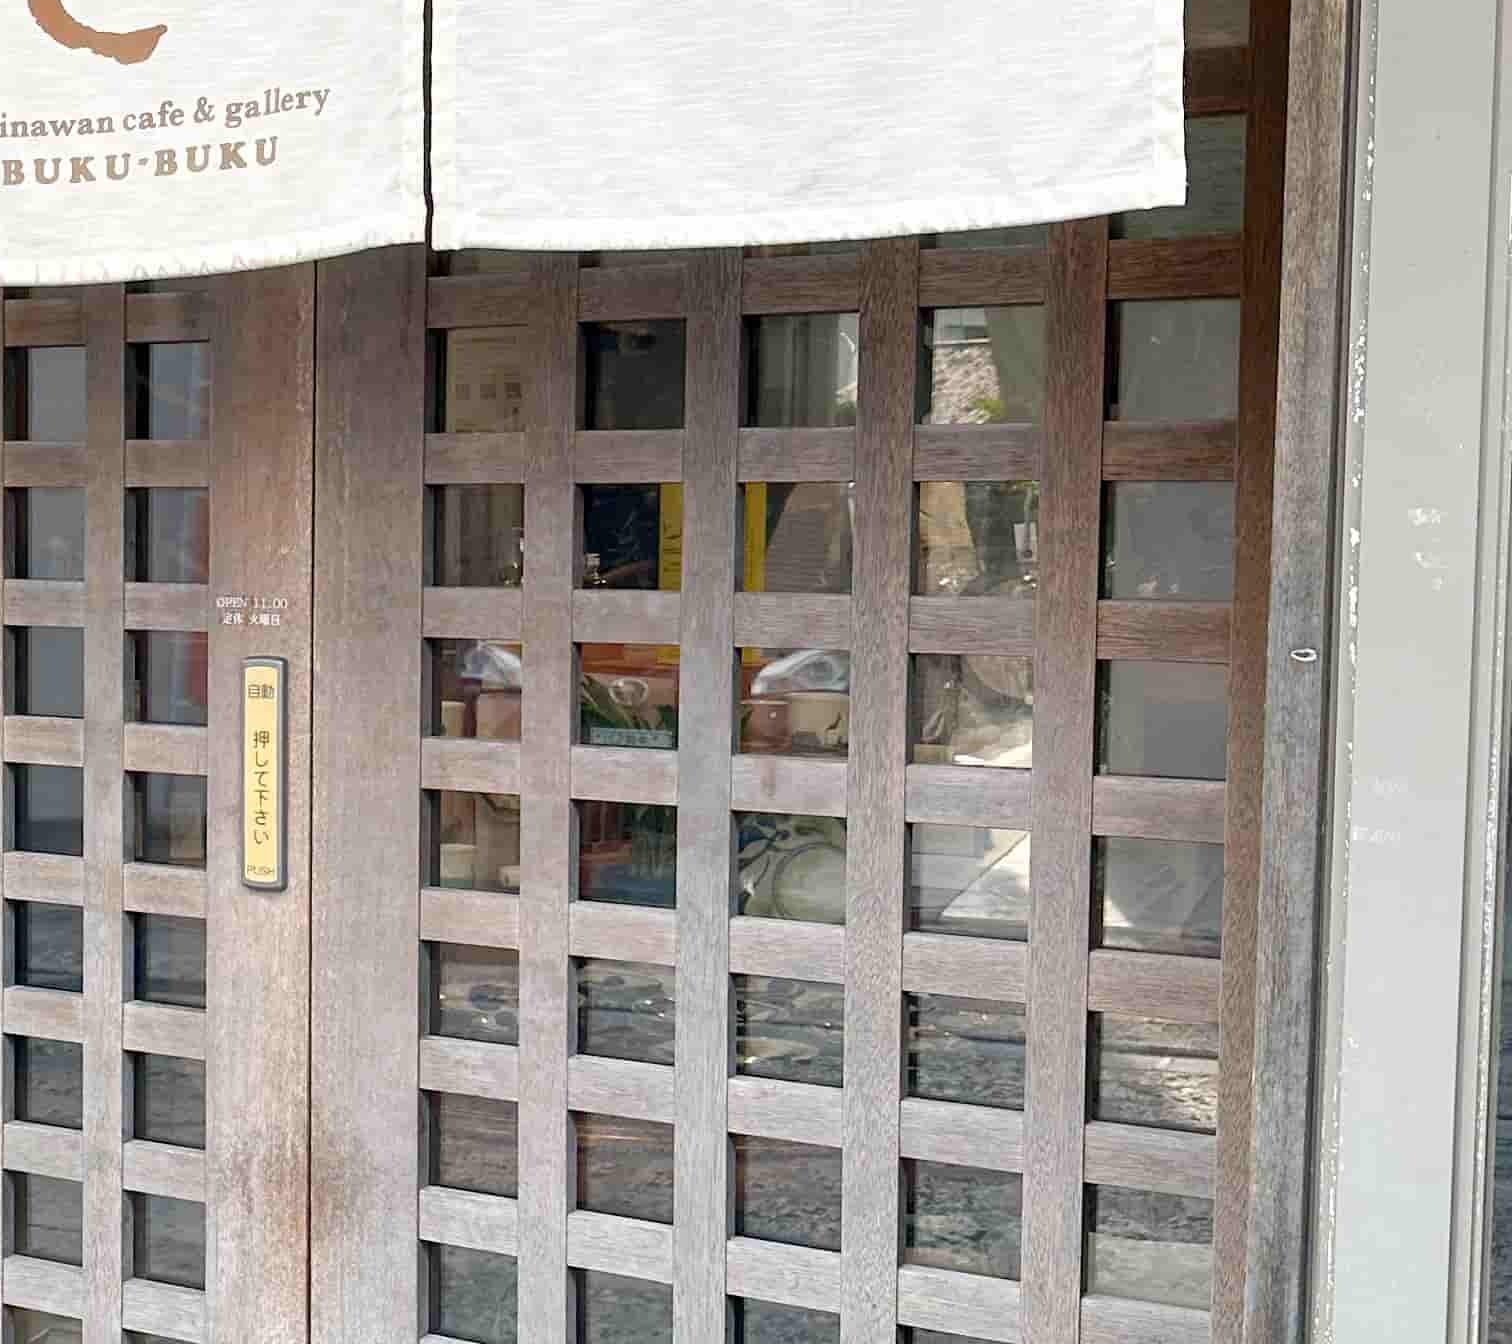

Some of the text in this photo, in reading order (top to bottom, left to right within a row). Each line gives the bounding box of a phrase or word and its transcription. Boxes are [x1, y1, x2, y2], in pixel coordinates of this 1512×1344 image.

[122, 100, 185, 132] cafe
[193, 96, 216, 124] &
[225, 87, 331, 128] gallery
[2, 135, 280, 186] BUKU-BUKU
[216, 596, 248, 608] OPEN
[247, 683, 275, 700] 自動
[252, 730, 270, 846] 押して下さい
